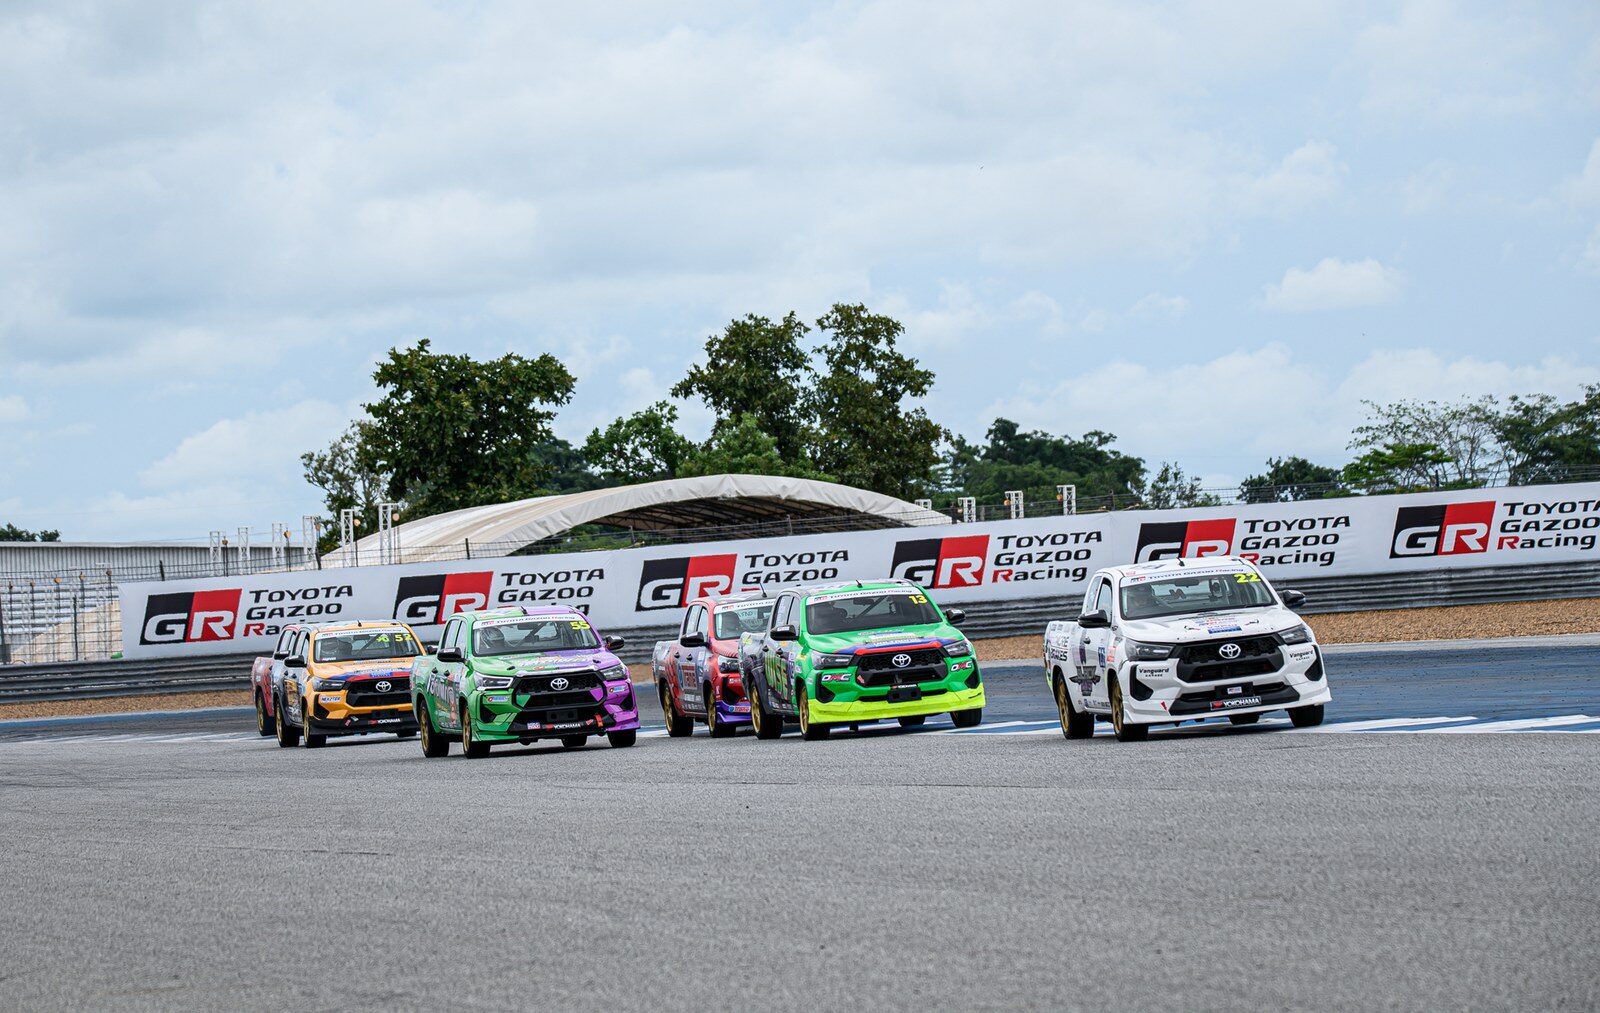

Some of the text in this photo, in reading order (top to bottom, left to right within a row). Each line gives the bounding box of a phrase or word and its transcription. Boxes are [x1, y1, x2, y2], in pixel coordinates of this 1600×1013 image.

[1243, 515, 1351, 534] TOYOTA
[1499, 516, 1600, 534] GAZOO
[997, 530, 1103, 550] TOYOTA
[1241, 533, 1340, 551] GAZOO
[1394, 522, 1489, 556] GR
[1497, 533, 1596, 551] Racing
[744, 549, 850, 569] TOYOTA
[993, 549, 1092, 567] GAZOO
[1239, 549, 1336, 567] Racing
[501, 568, 605, 587] TOYOTA
[742, 567, 839, 585] GAZOO
[890, 556, 984, 588] GR
[991, 566, 1088, 583] Racing
[1233, 572, 1261, 585] 22
[249, 585, 353, 604] TOYOTA
[498, 586, 595, 603] GAZOO
[640, 575, 732, 609] GR
[908, 595, 928, 605] 13
[246, 602, 343, 620] GAZOO
[396, 592, 488, 625] GR
[143, 610, 235, 643] GR
[570, 621, 591, 630] 55
[1223, 698, 1261, 708] YOKOHAMA
